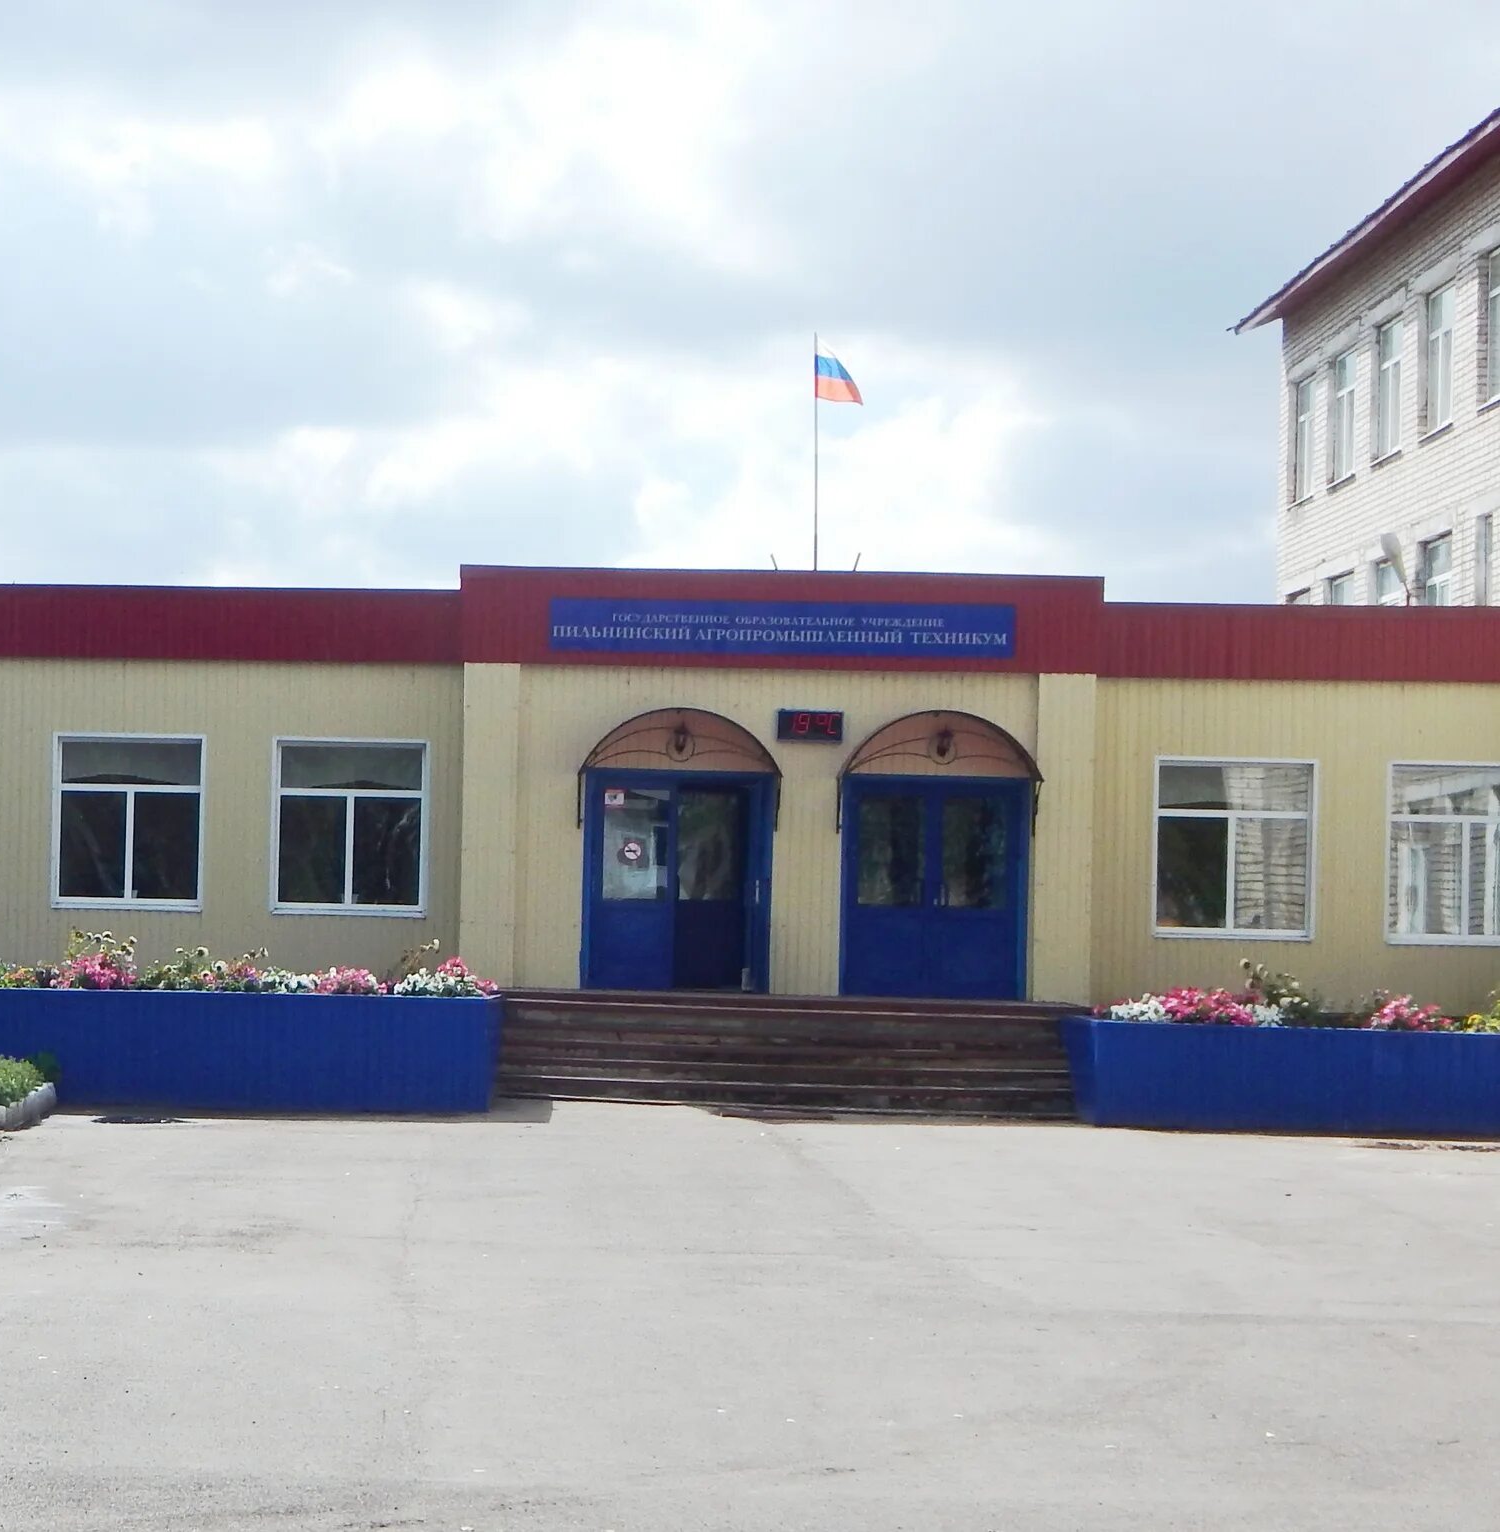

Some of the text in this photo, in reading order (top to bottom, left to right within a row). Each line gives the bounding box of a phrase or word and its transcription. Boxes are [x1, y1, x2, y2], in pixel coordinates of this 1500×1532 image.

[612, 612, 945, 628] ГОСУДАРСТВЕННОЕ ОБРАЗОВАТЕЛЬНОЕ УЧРЕЖДЕНИЕ
[552, 625, 1007, 645] ПИЛЬНИНСКИЙ АГРОПРОМЫШЛЕННЫЙ ТЕХНИКУМ
